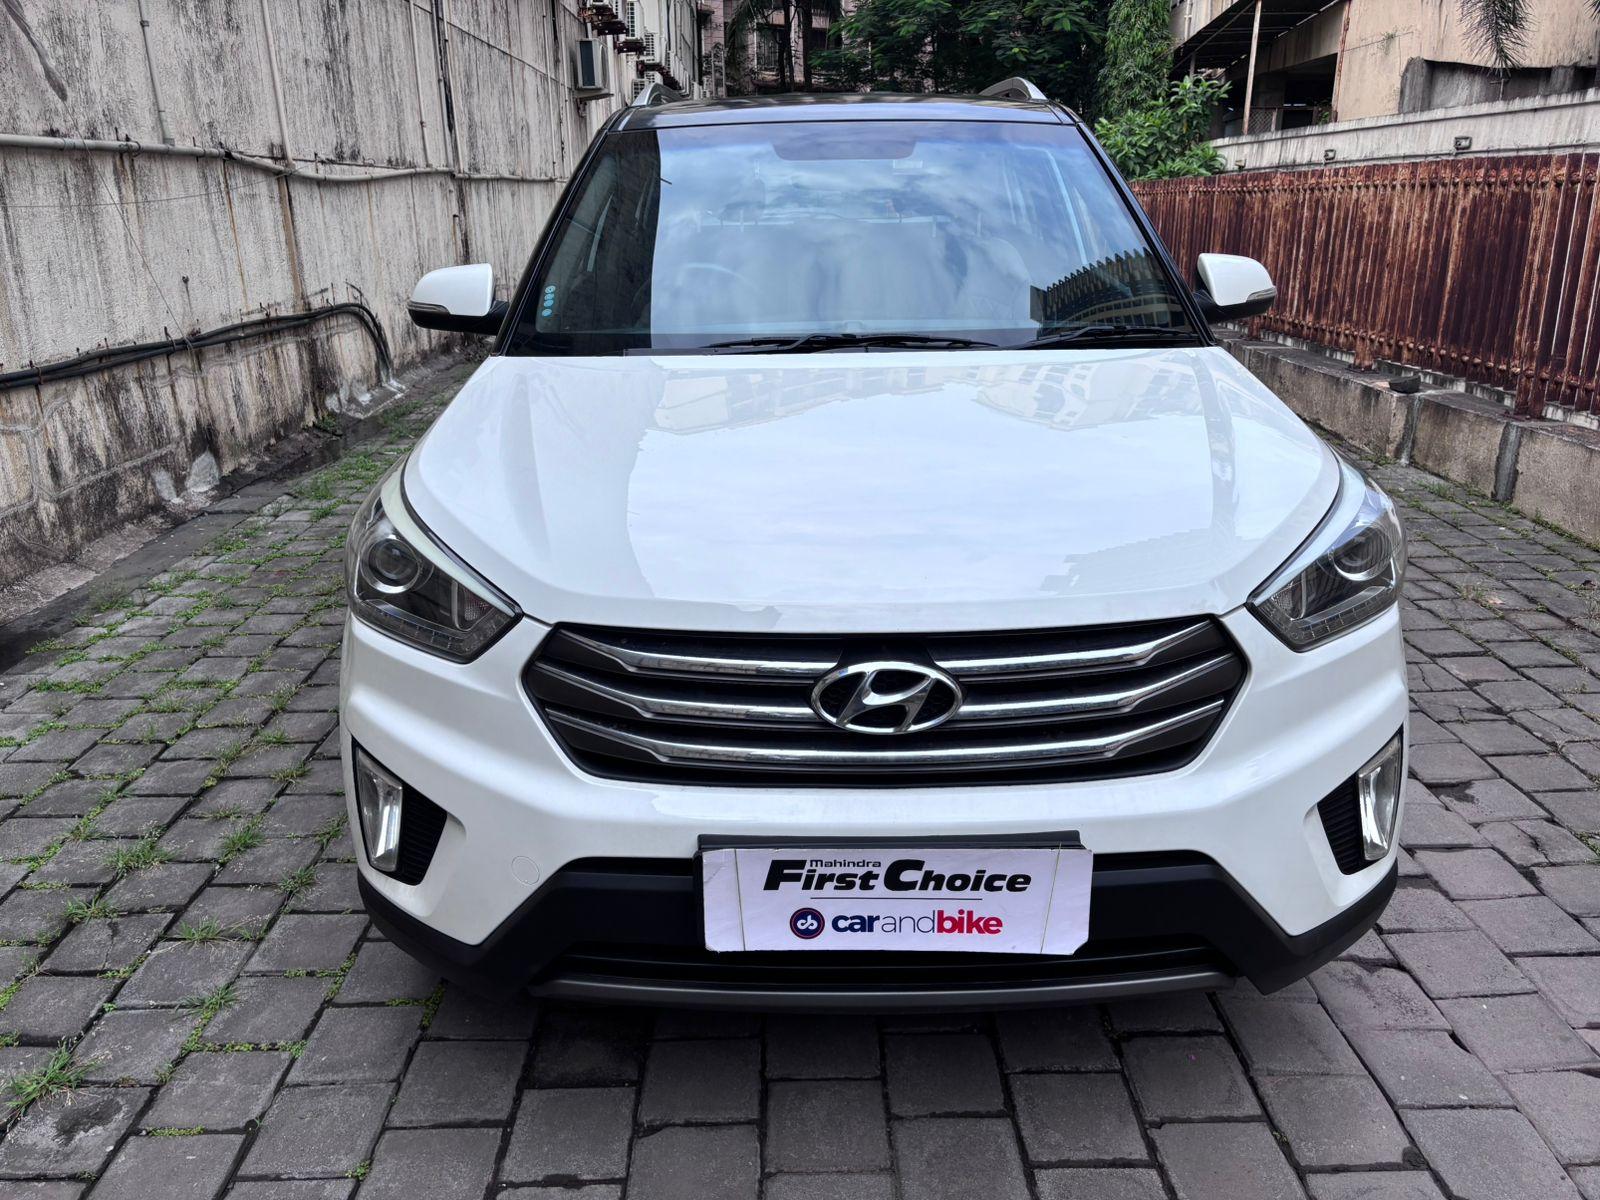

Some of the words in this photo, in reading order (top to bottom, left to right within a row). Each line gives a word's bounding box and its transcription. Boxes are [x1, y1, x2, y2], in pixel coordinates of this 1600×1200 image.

[763, 859, 880, 891] First
[883, 859, 1032, 892] Choice
[810, 859, 881, 868] Mahindra
[831, 908, 1003, 935] carandbike
